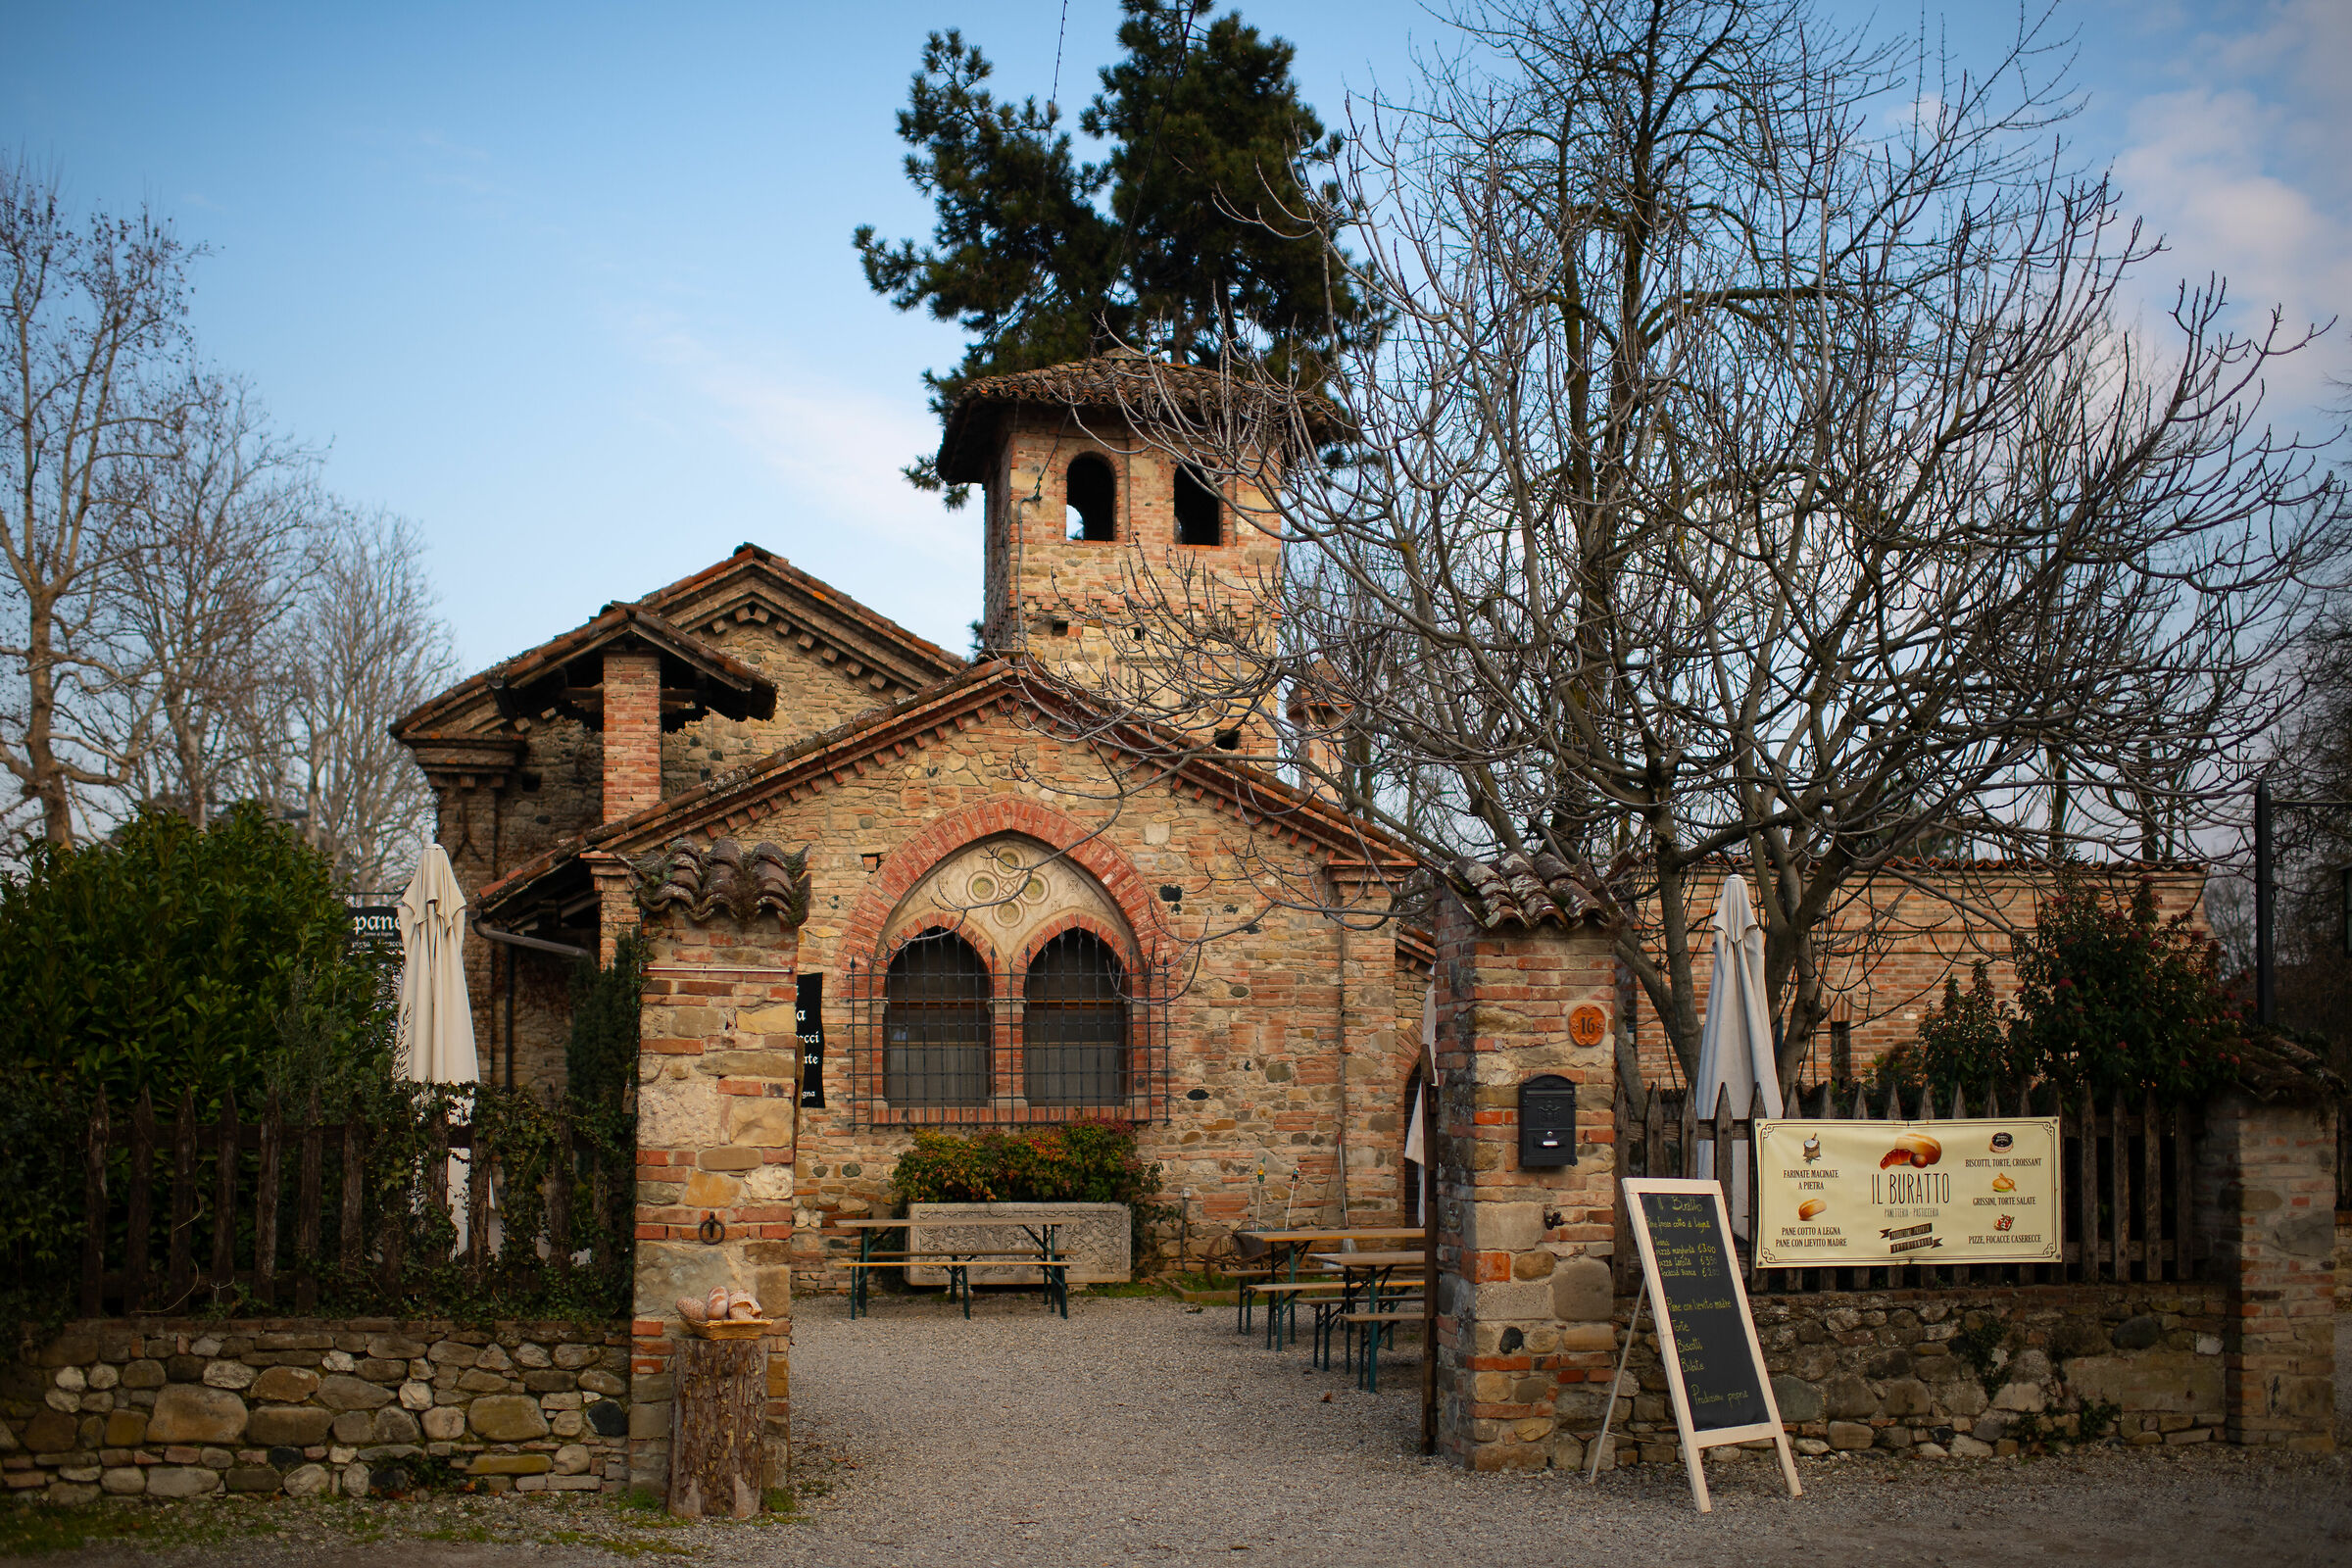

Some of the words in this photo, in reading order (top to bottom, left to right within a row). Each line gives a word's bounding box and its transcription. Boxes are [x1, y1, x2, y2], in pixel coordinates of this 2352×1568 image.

[1581, 1016, 1595, 1035] 16
[1965, 1159, 1991, 1168] BISCOTTI,
[1992, 1159, 2011, 1168] TORTE,
[2013, 1158, 2041, 1167] CROISSANT
[1811, 1169, 1838, 1178] MACINATE
[1798, 1181, 1803, 1190] A
[1803, 1181, 1825, 1190] PIETRA
[1871, 1173, 1884, 1204] IL
[1889, 1172, 1949, 1204] BURATTO
[1972, 1198, 1996, 1206] GRISSINI,
[1997, 1197, 2016, 1205] TORTE
[2016, 1197, 2036, 1205] SALATE
[1796, 1227, 1816, 1236] COTTO
[1791, 1239, 1803, 1248] CON
[1803, 1239, 1827, 1248] LIEVITO
[2011, 1235, 2041, 1244] CASERECCE
[1671, 1319, 1690, 1332] Torte
[1676, 1337, 1703, 1353] Biscotti
